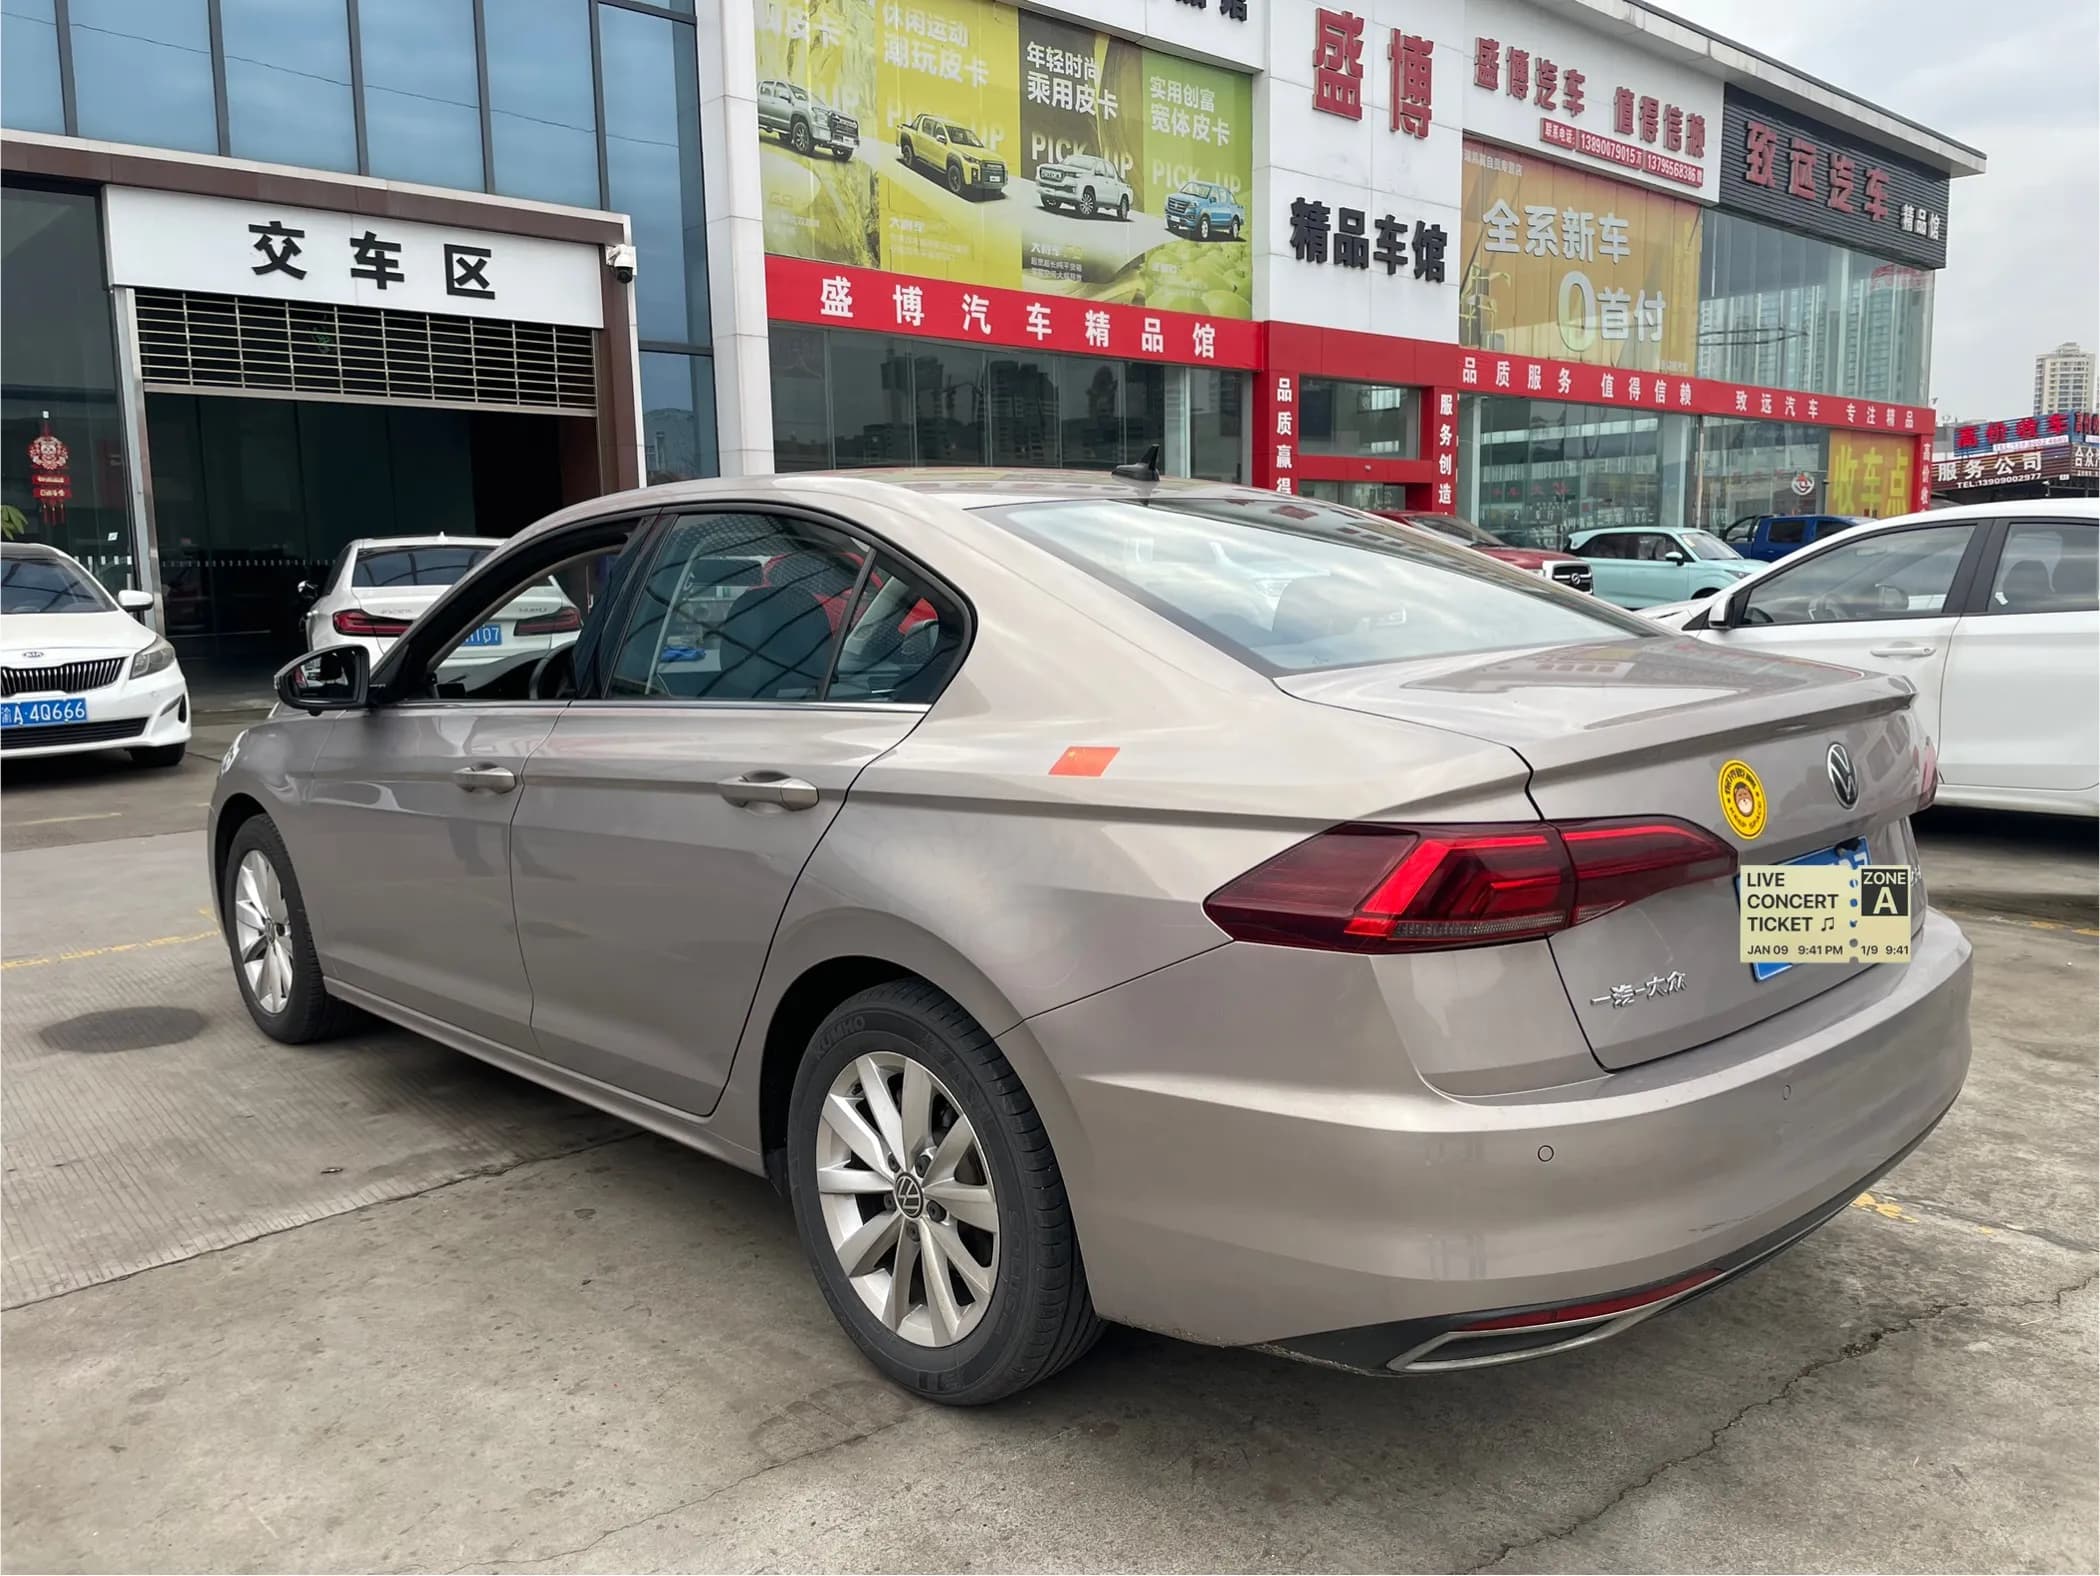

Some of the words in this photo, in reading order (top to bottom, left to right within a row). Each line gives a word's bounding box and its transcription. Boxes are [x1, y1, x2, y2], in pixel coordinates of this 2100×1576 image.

[882, 5, 969, 48] 休闲运动
[1027, 41, 1098, 81] 年轻时尚
[1027, 70, 1118, 120] 乘用皮卡
[1150, 75, 1215, 113] 实用创富
[1312, 7, 1434, 139] 盛博
[1474, 37, 1585, 117] 盛博汽车
[1614, 86, 1705, 158] 值得信赖
[1151, 103, 1230, 146] 宽体皮卡
[1746, 120, 1889, 222] 致远汽车
[1901, 203, 1940, 241] 精品馆
[249, 221, 495, 300] 交车区
[1290, 197, 1447, 283] 精品车馆
[1483, 199, 1632, 265] 全系新车
[820, 276, 1217, 359] 盛博汽车精品馆
[1558, 271, 1667, 352] 0首付
[1462, 357, 1573, 394] 品质服务
[1601, 373, 1692, 406] 值得信赖
[1736, 391, 1819, 419] 致远汽车
[1439, 394, 1453, 515] 服务创造
[1834, 445, 1909, 518] 收车点
[1937, 452, 2042, 481] 服务公司
